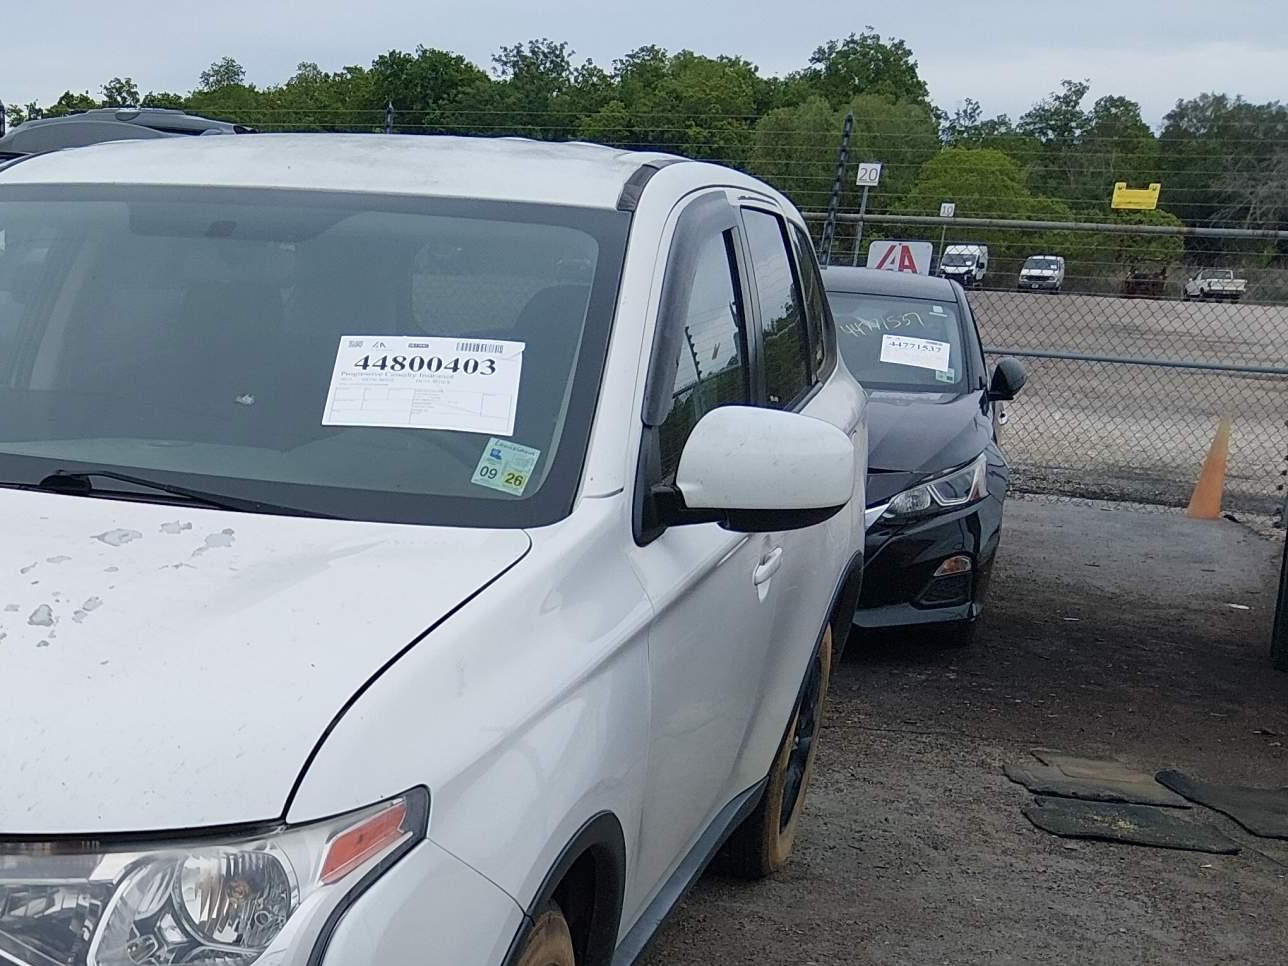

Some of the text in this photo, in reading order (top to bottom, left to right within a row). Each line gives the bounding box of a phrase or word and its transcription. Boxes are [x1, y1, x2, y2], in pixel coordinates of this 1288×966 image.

[858, 167, 879, 181] 20
[354, 354, 497, 375] 44800403
[479, 466, 523, 486] 09 26
